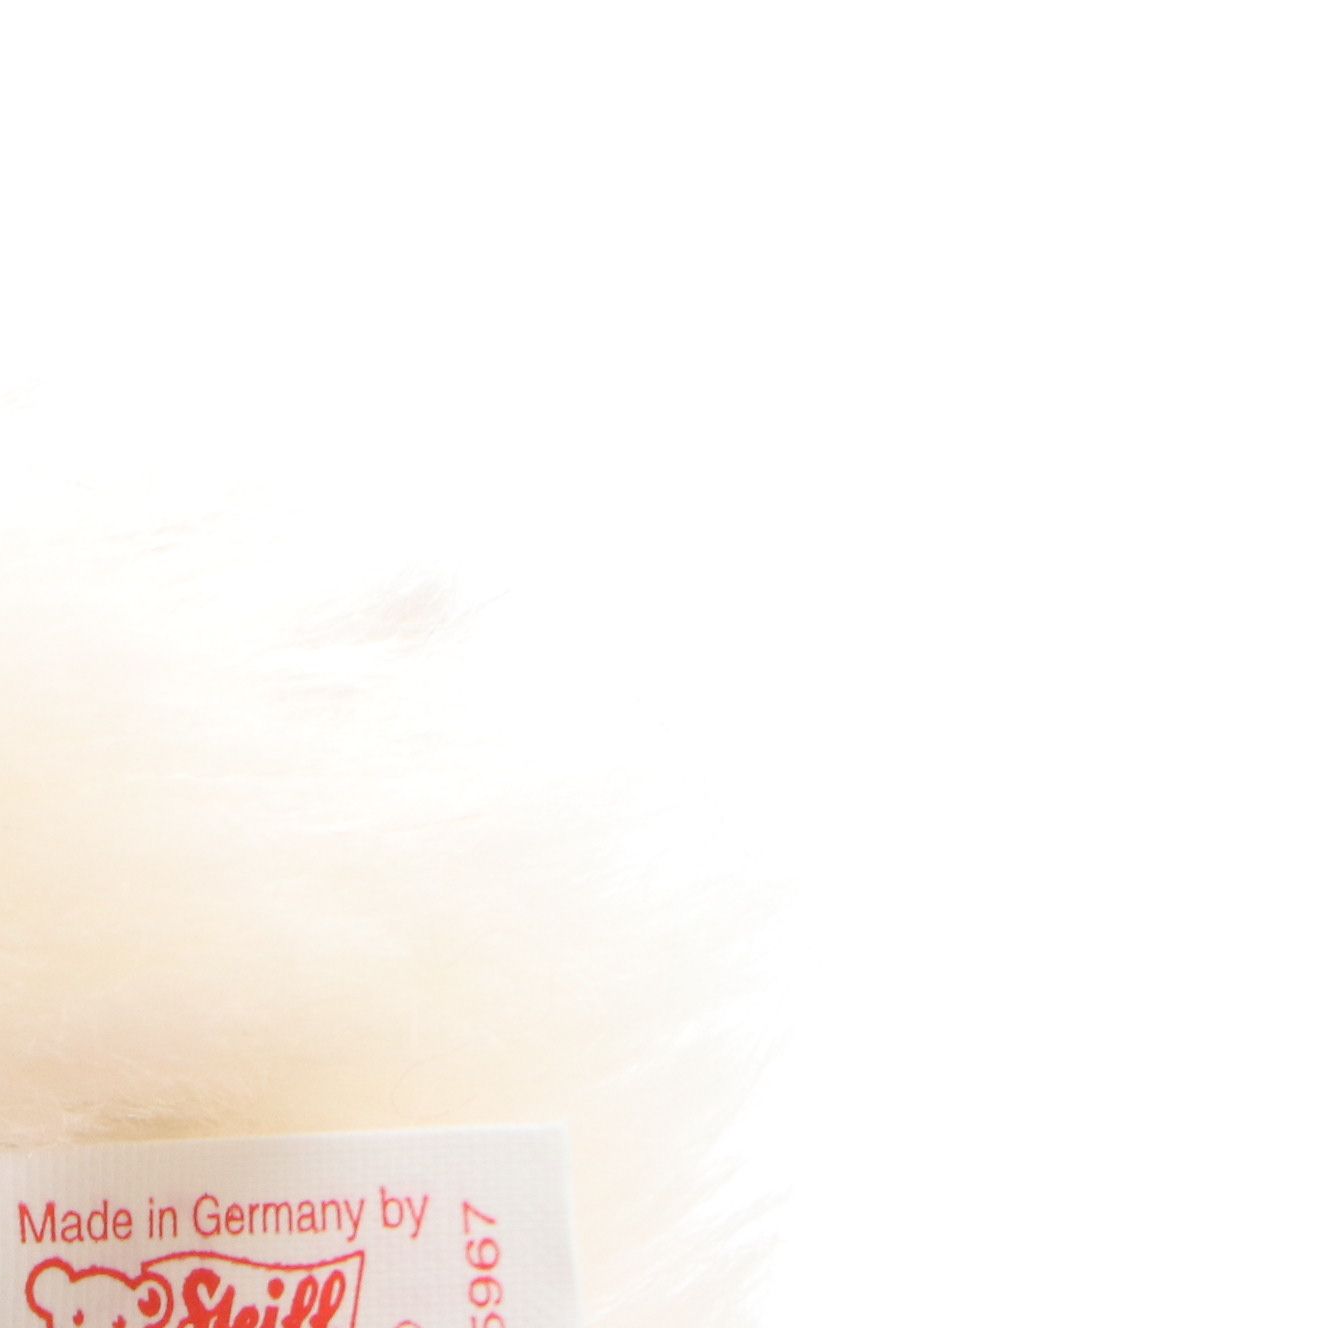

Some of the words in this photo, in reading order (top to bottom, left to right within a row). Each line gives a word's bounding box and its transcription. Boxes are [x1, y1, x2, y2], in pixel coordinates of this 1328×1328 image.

[17, 1199, 135, 1245] Made
[146, 1196, 181, 1240] in
[190, 1190, 367, 1246] Germany
[378, 1185, 433, 1242] by
